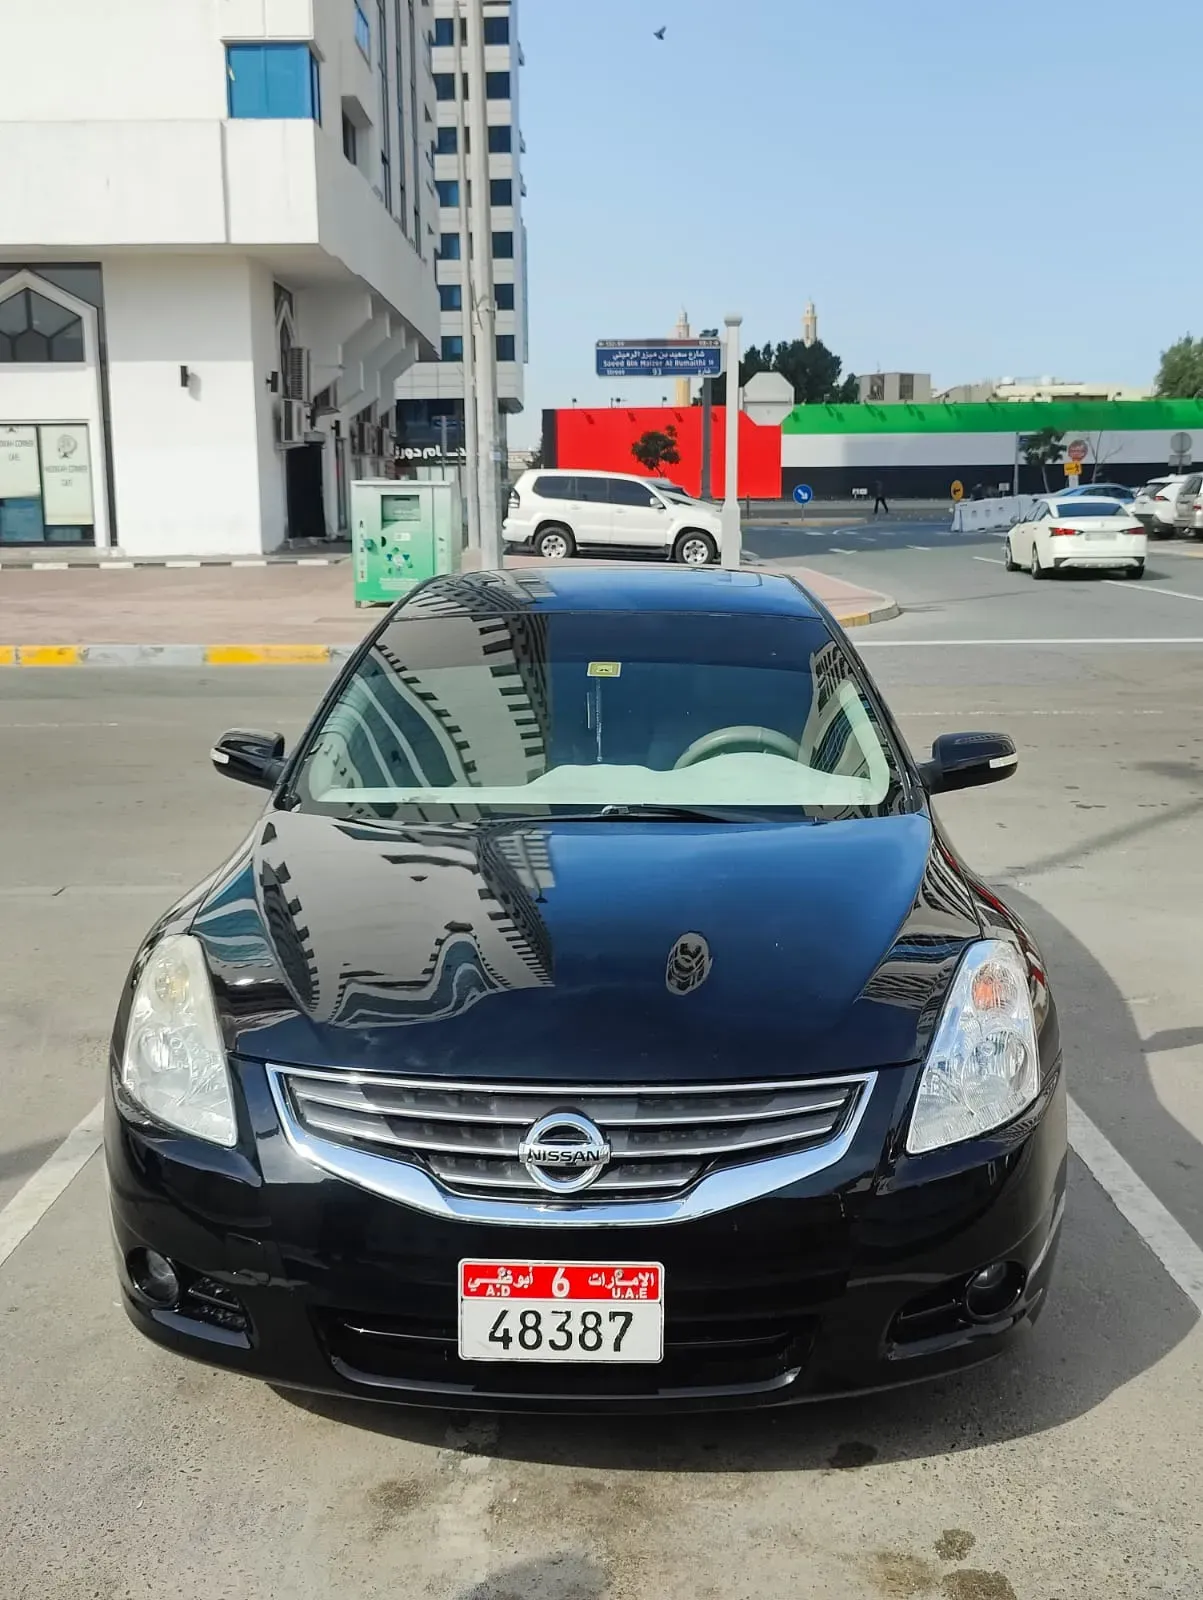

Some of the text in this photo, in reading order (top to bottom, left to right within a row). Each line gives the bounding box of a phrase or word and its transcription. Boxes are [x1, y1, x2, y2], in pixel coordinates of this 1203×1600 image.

[603, 360, 625, 368] Saeed
[527, 1148, 601, 1163] NISSAN
[551, 1267, 571, 1298] 6
[486, 1285, 511, 1297] A.D
[611, 1287, 648, 1299] U.A.E
[488, 1309, 634, 1353] 48387
